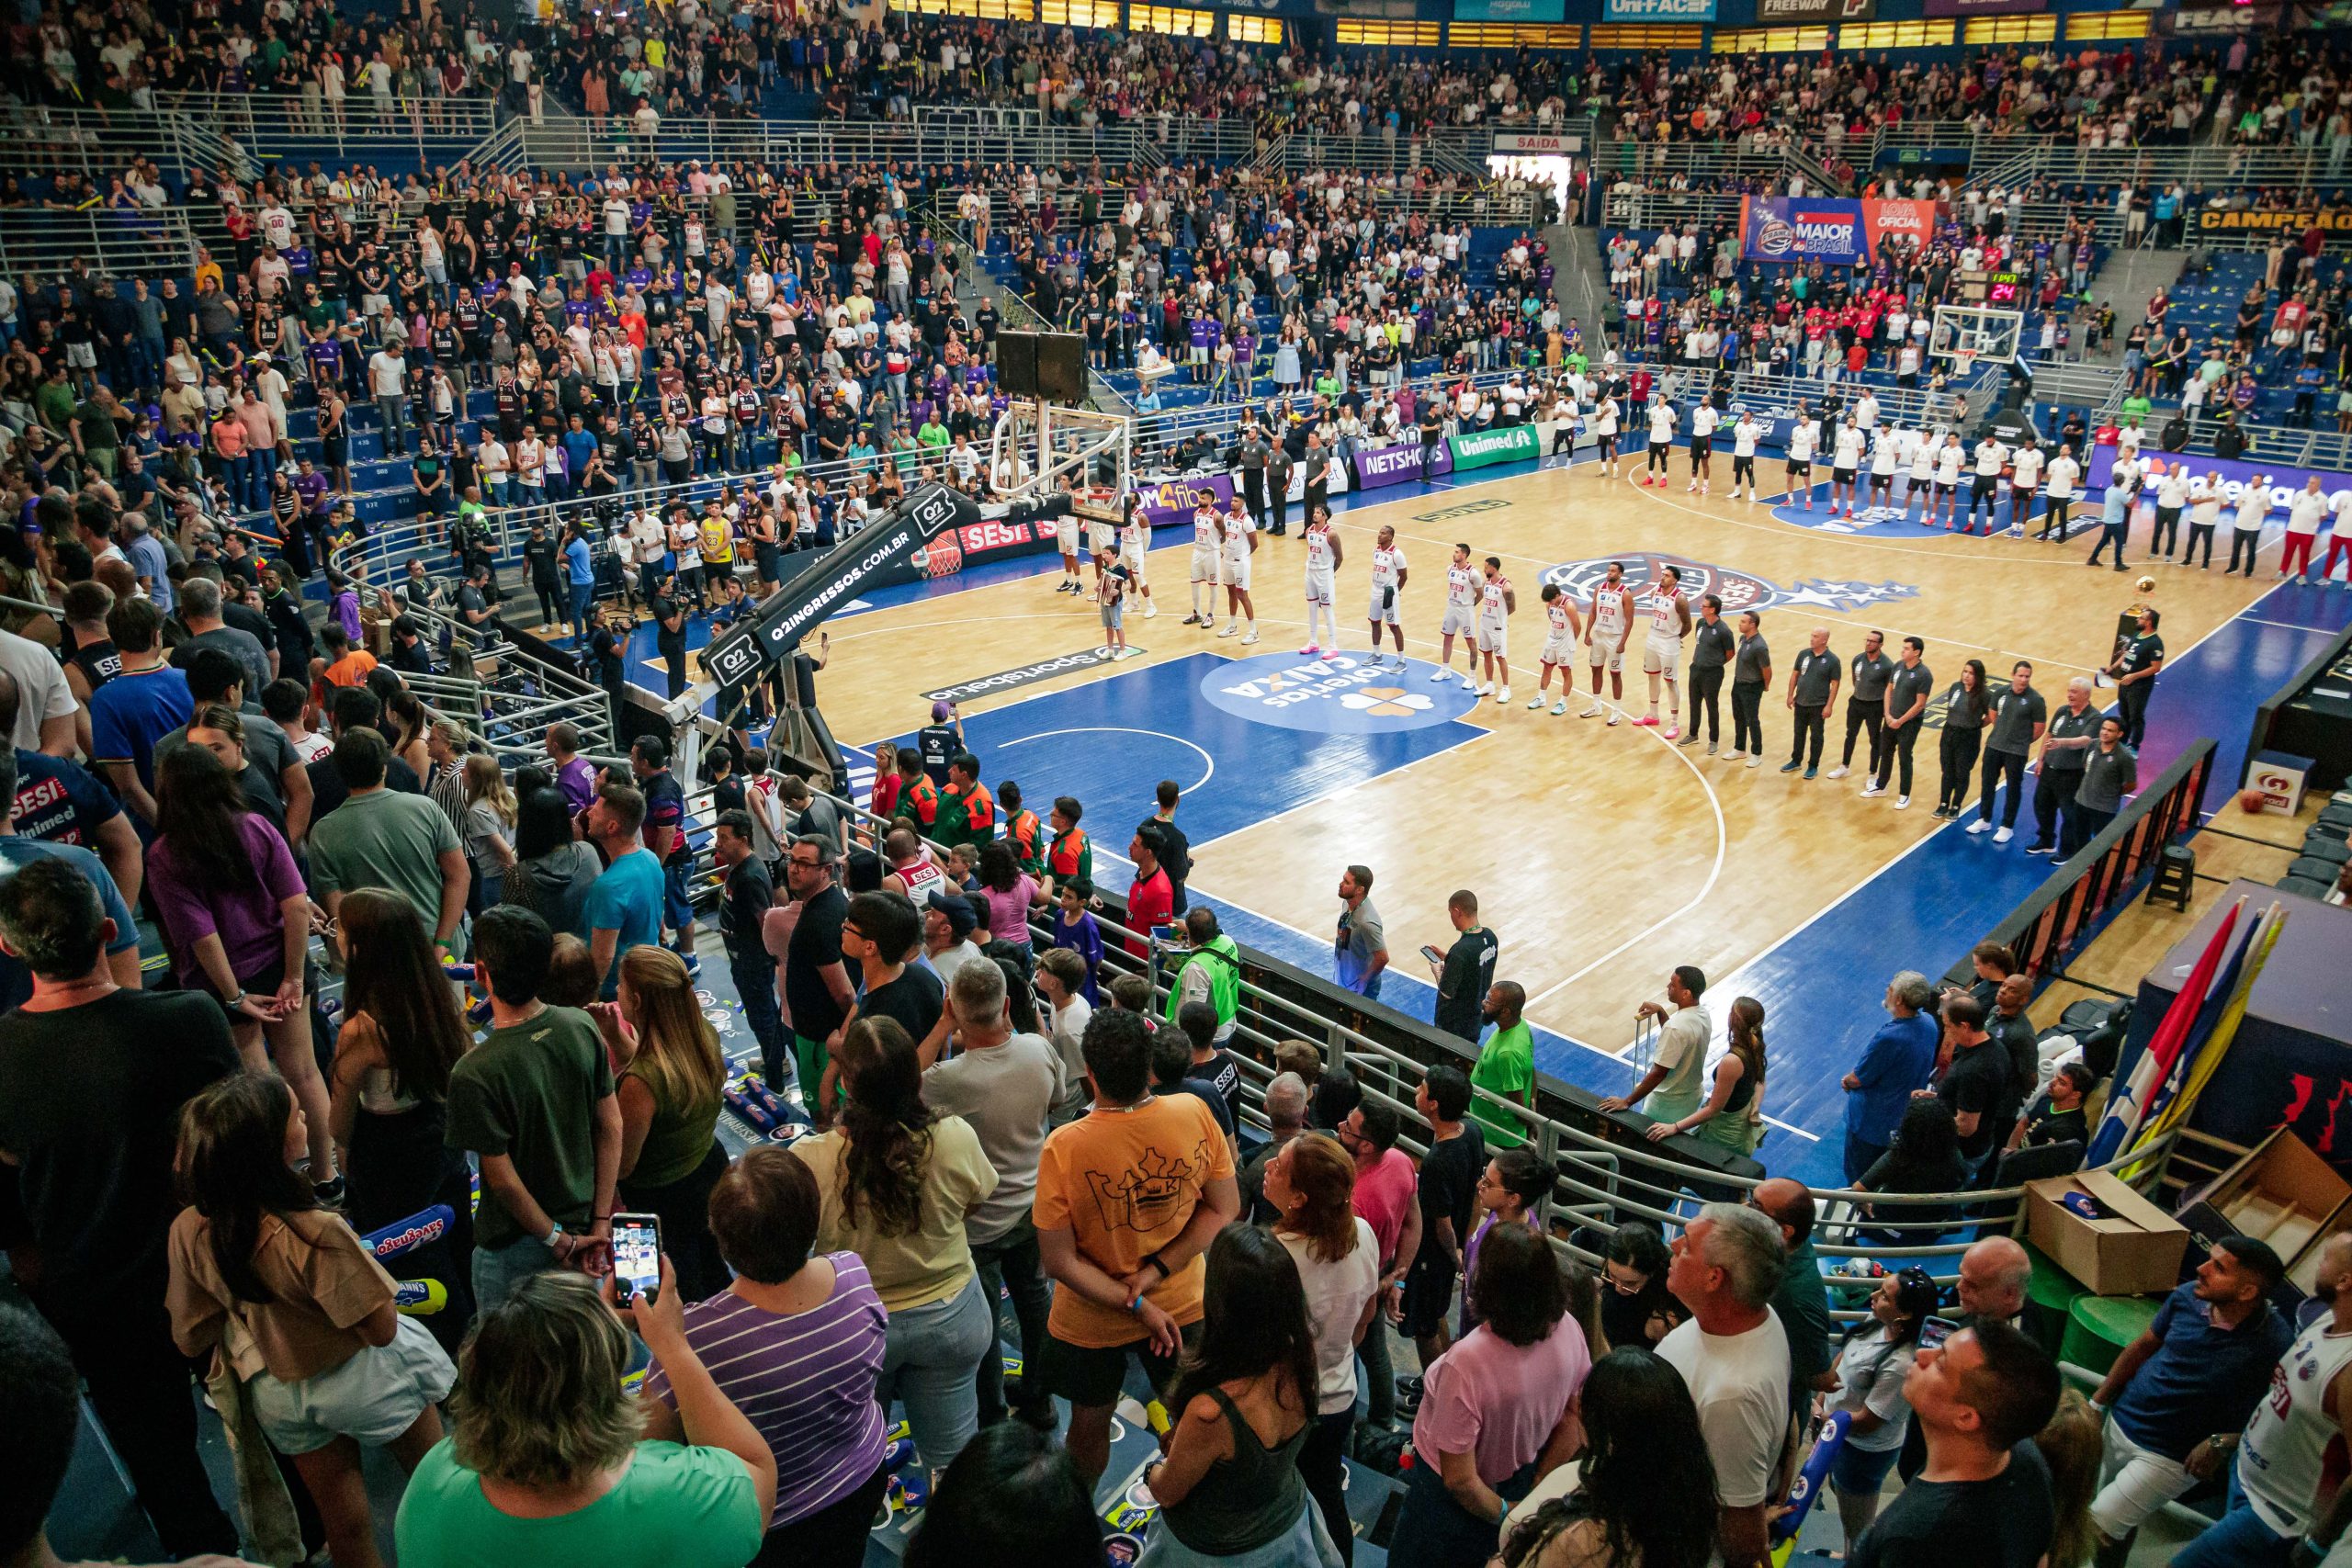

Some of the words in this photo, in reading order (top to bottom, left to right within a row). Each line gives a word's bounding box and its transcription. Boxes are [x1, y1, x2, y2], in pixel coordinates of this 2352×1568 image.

[1763, 0, 1827, 11] FREEWAY
[2175, 8, 2256, 28] FEAC
[1881, 203, 1917, 217] LOJA
[1796, 223, 1853, 240] MAIOR
[1877, 217, 1922, 229] OFICIAL
[1792, 241, 1805, 252] do
[1804, 239, 1856, 254] BRASIL
[1991, 284, 2015, 299] 24
[1459, 432, 1514, 457] Unimed
[1365, 445, 1443, 474] NETSHOS
[922, 501, 943, 521] Q2
[707, 536, 718, 547] 23
[967, 525, 1023, 550] SESI
[771, 531, 910, 642] Q2INGRESSOS.COM.BR
[723, 649, 747, 671] Q2
[1220, 656, 1358, 699] CAIXA
[8, 780, 60, 820] SESI
[915, 869, 934, 882] SESI
[1217, 1066, 1234, 1089] SESI
[377, 1218, 445, 1256] Savegnago
[401, 1282, 425, 1293] ANN'S
